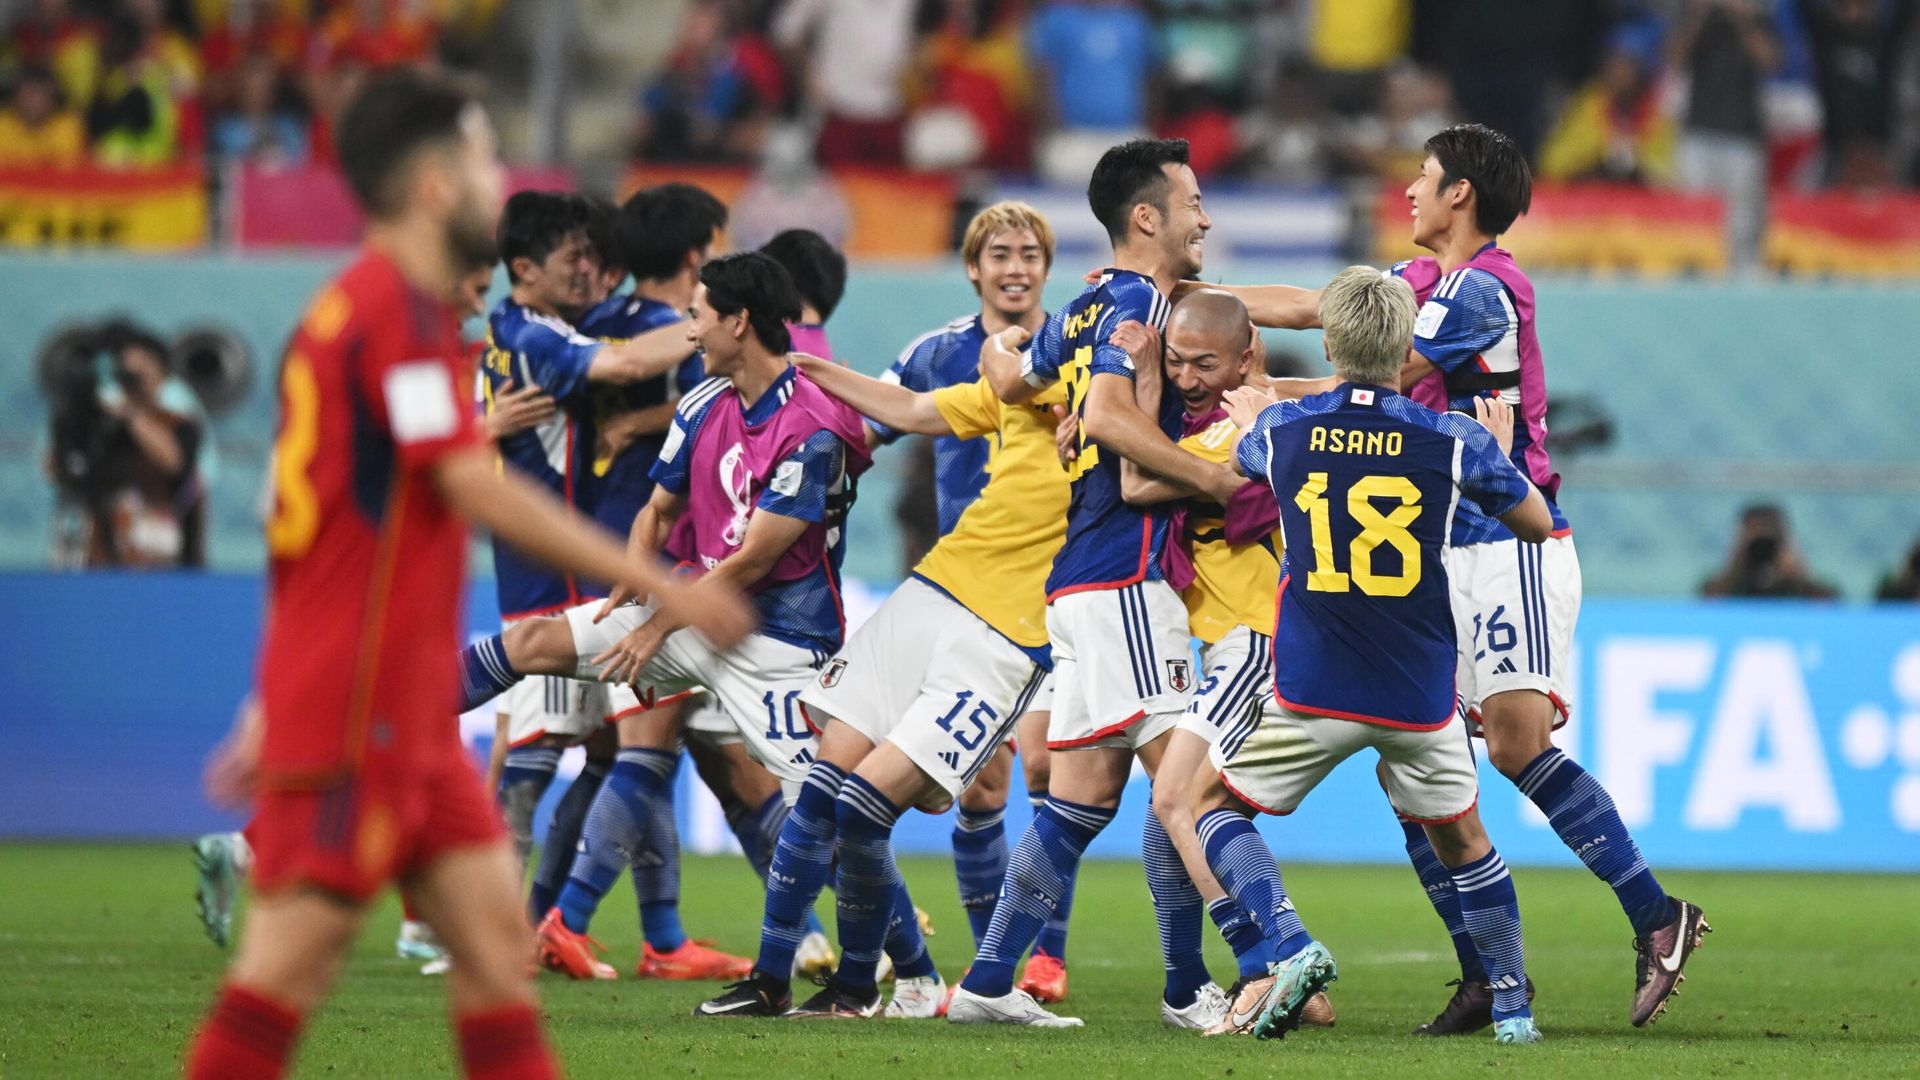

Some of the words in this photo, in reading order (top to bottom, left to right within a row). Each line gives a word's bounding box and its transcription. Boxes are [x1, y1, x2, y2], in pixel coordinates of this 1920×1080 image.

[1310, 426, 1403, 457] ASANO
[1294, 472, 1423, 598] 18
[762, 690, 814, 740] 10
[935, 689, 999, 751] 15
